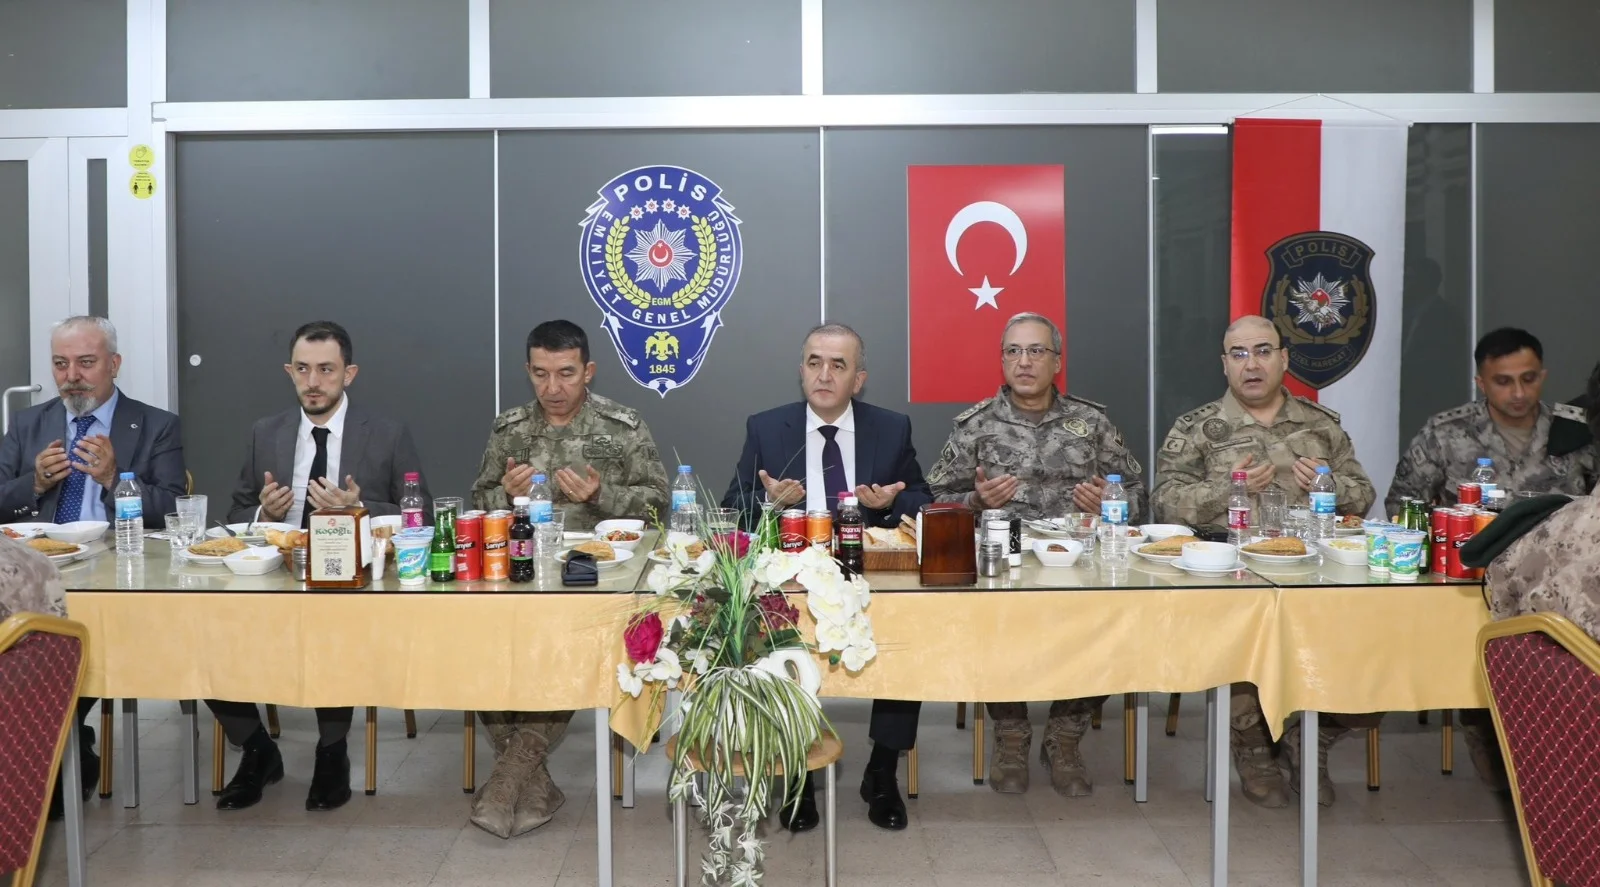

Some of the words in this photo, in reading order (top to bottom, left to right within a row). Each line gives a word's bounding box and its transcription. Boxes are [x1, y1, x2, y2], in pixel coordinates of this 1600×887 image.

[613, 172, 707, 201] POLİS
[1296, 242, 1347, 257] POLİS
[591, 211, 622, 305] EMNİYET
[632, 308, 691, 324] GENEL
[696, 210, 731, 310] MÜDÜRLÜĞÜ
[651, 298, 672, 306] EGM
[649, 365, 676, 374] 1845
